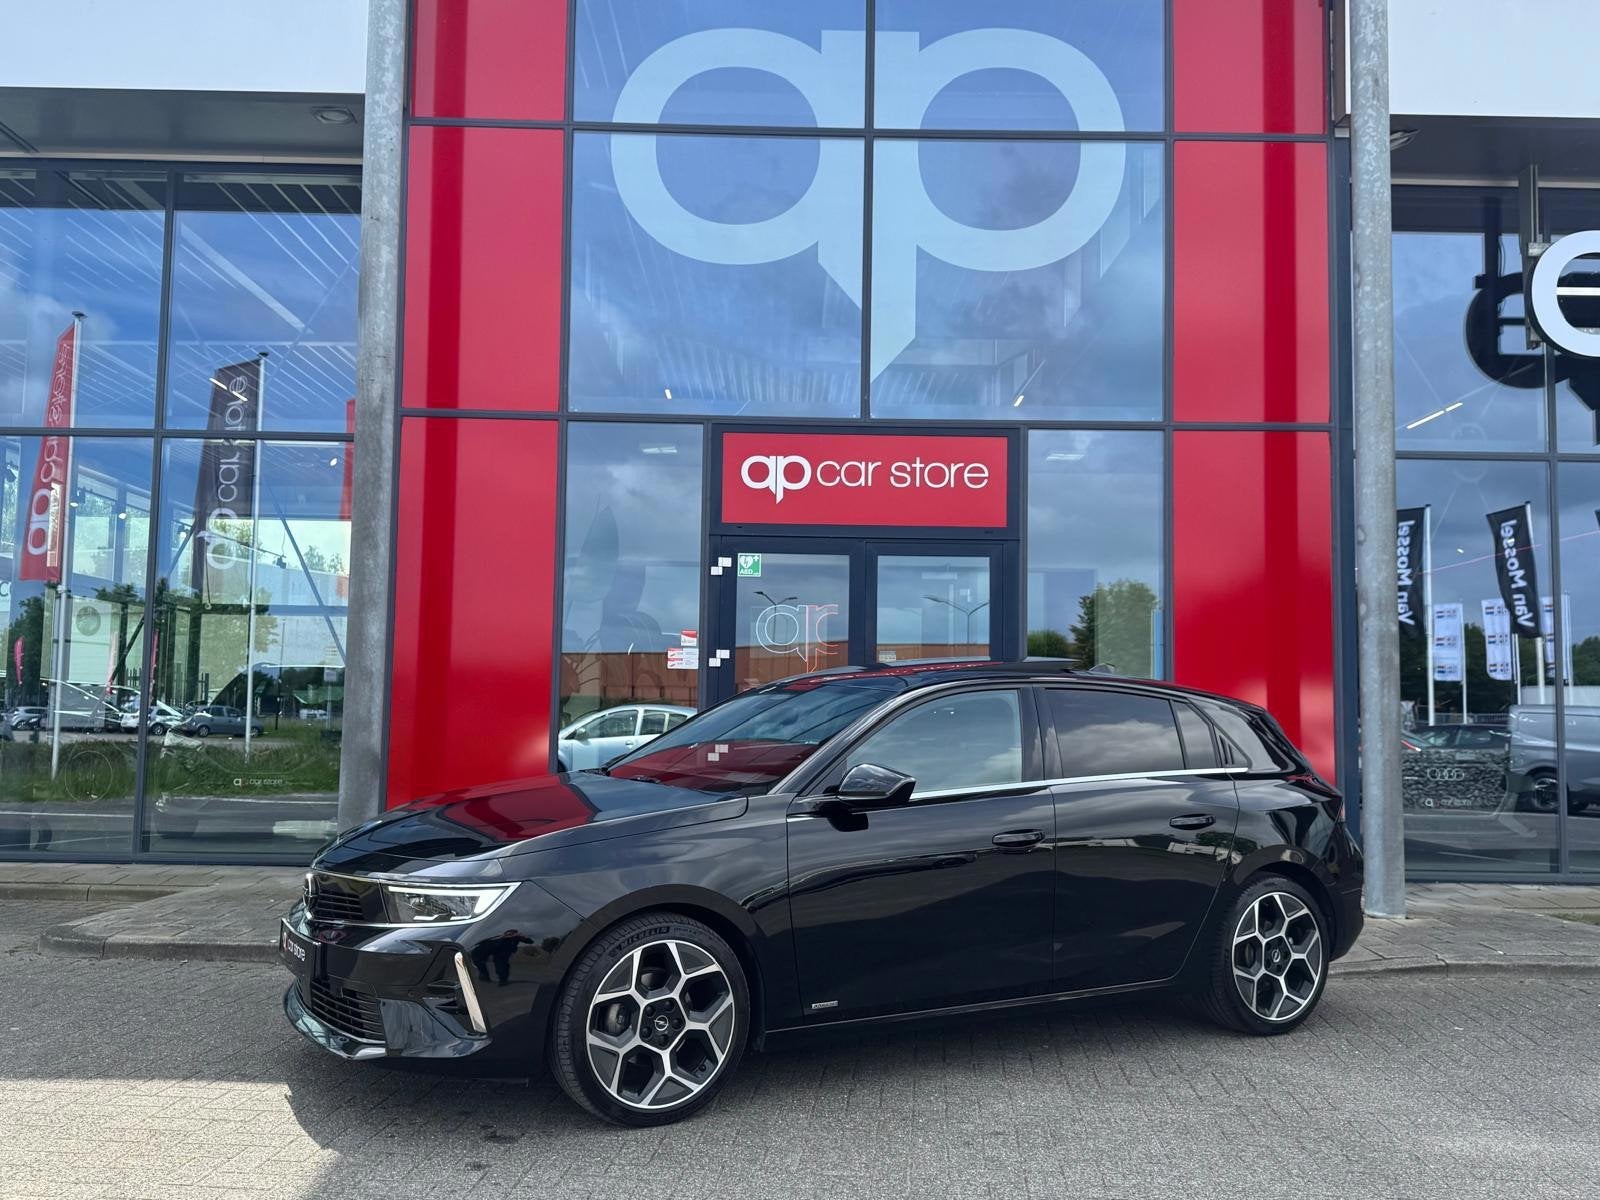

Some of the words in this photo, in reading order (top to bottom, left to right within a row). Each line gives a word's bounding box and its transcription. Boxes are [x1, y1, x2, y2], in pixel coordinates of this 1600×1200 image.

[611, 27, 1126, 383] ap
[740, 455, 812, 504] ap
[816, 460, 882, 487] car
[889, 457, 989, 489] store
